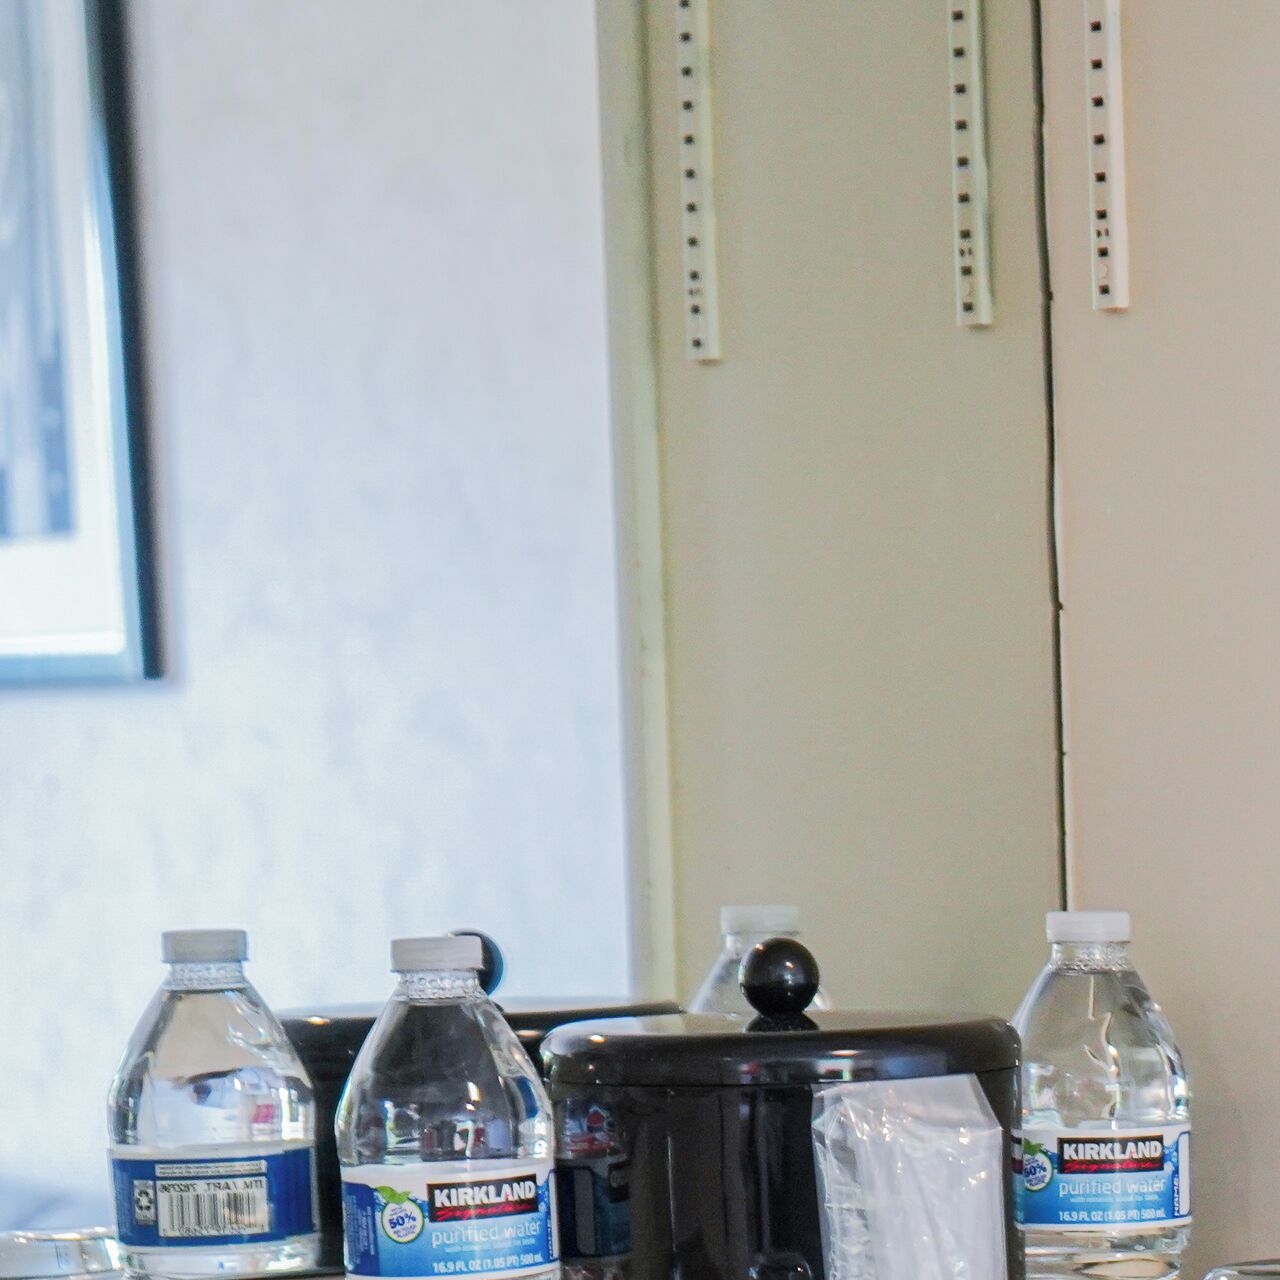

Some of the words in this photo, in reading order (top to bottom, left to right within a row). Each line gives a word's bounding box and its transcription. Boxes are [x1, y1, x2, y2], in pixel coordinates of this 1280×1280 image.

[1063, 1140, 1163, 1161] KIRKLAND
[434, 1181, 537, 1208] KIRKLAND
[1059, 1180, 1122, 1198] purified
[1127, 1178, 1166, 1194] water
[389, 1211, 417, 1229] 50%
[1059, 1211, 1078, 1222] 16.9
[432, 1223, 499, 1249] purified
[504, 1221, 542, 1239] water
[432, 1261, 455, 1274] 16.9
[455, 1260, 468, 1273] FL
[468, 1258, 482, 1272] OZ
[482, 1257, 505, 1271] (1.05
